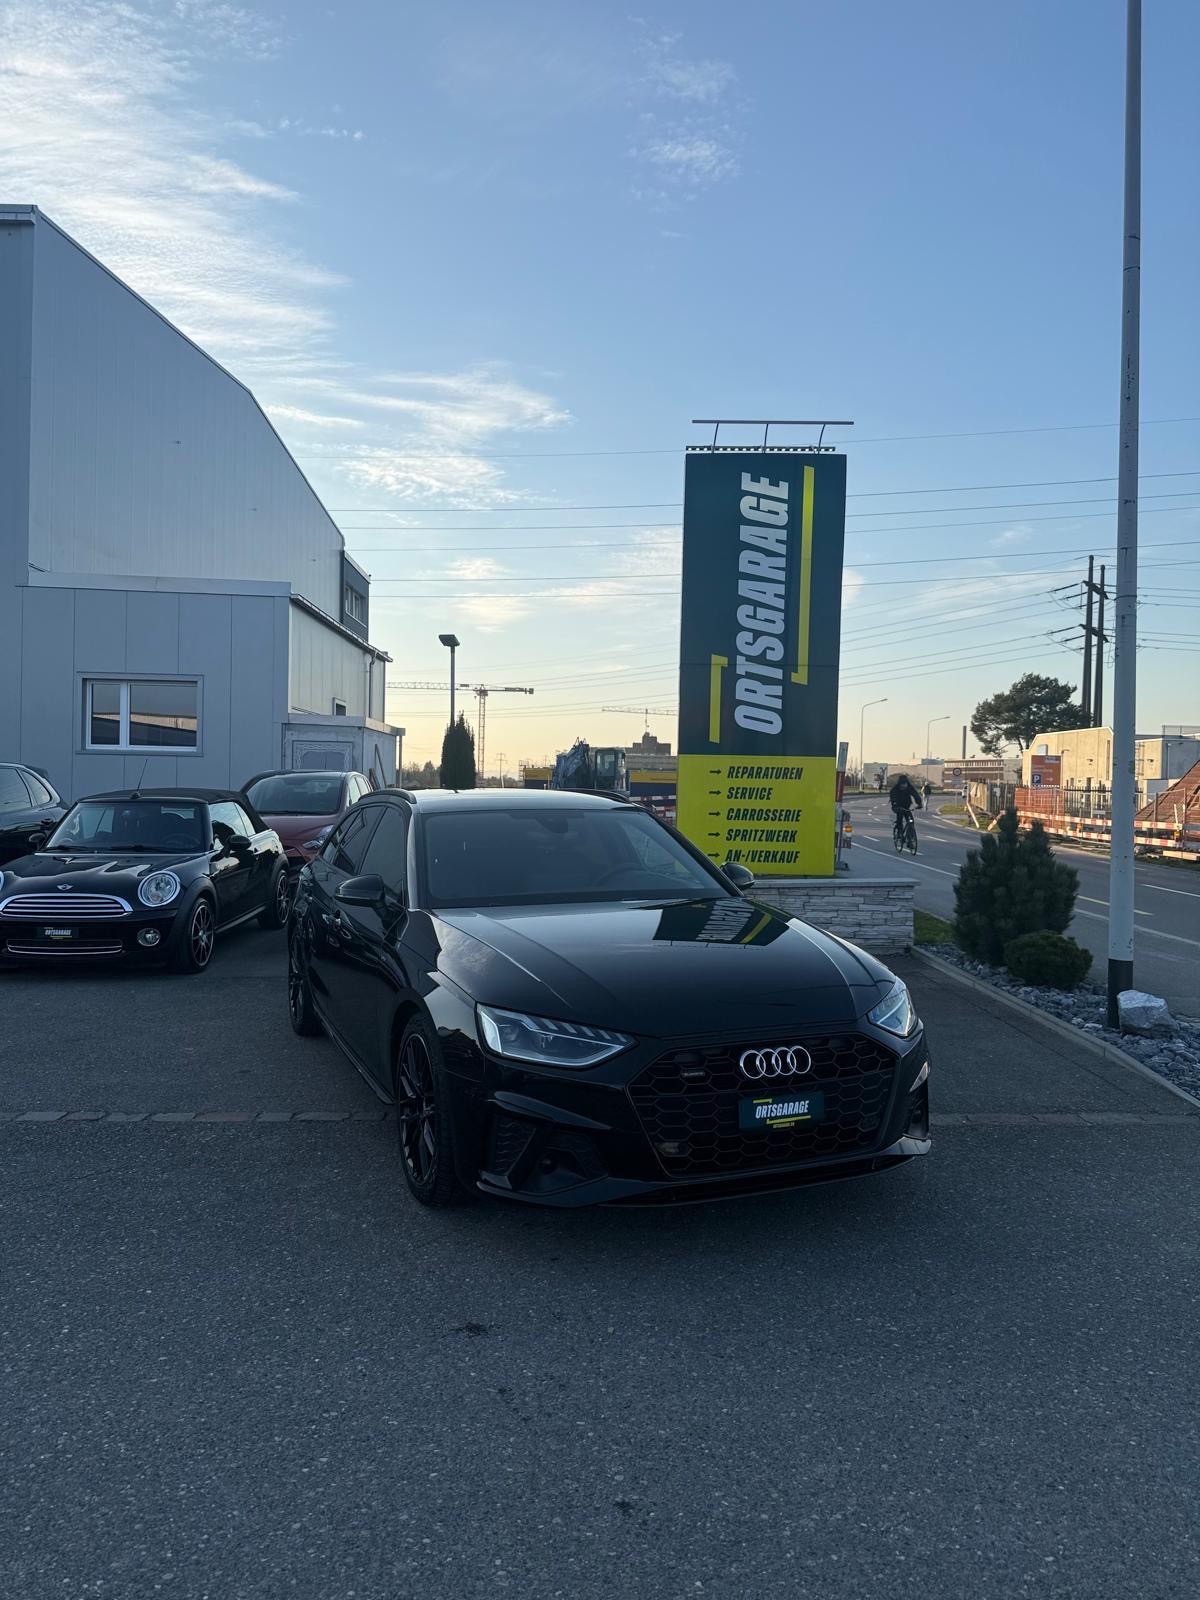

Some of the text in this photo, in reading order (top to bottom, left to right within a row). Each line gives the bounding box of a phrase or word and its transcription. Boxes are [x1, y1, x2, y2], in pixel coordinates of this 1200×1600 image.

[734, 471, 789, 735] ORTSGARAGE
[727, 766, 803, 780] REPARATUREN
[726, 787, 773, 800] SERVICE
[726, 808, 802, 822] CARROSSERIE
[725, 829, 798, 843] SPRITZWERK
[725, 849, 800, 863] AN-/VERKAUF
[755, 1100, 809, 1119] ORTSGARAGE
